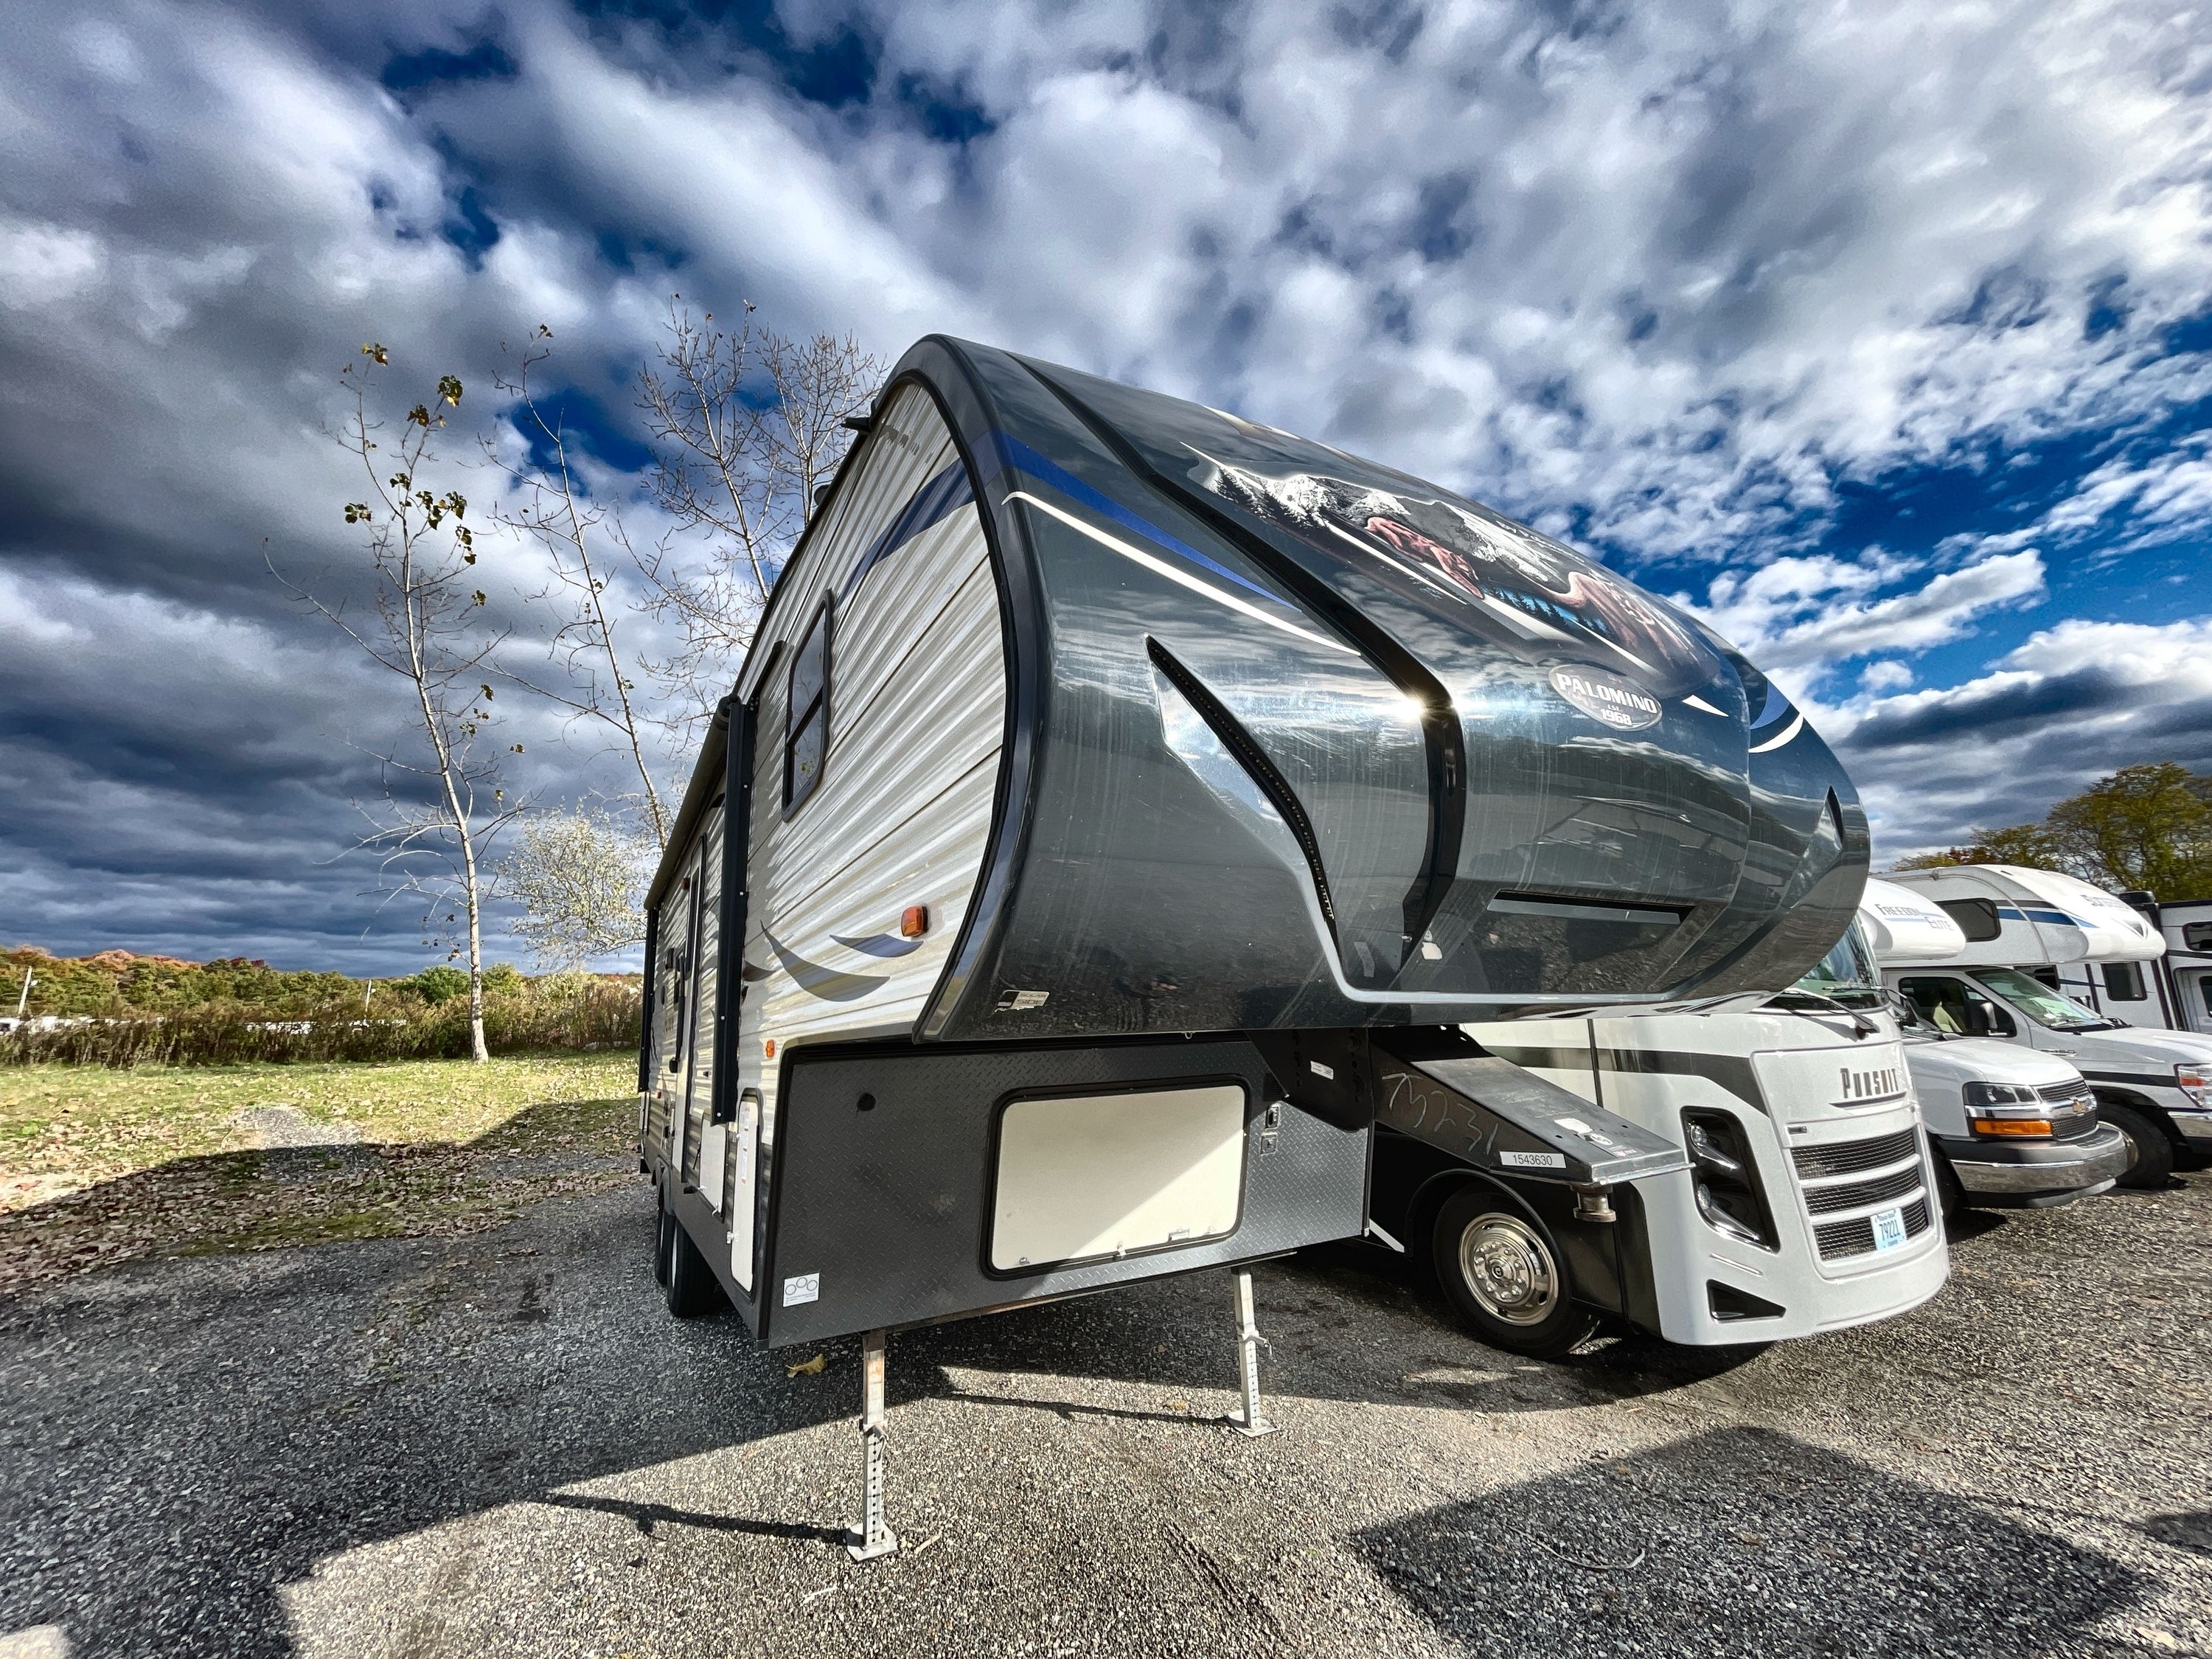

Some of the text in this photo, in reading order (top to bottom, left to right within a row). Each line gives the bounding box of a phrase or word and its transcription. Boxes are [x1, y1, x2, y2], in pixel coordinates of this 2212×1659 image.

[1556, 672, 1658, 714] PALOMINO
[1601, 708, 1632, 726] 1968
[1512, 1154, 1553, 1166] 1543630
[1879, 1219, 1901, 1242] 79221
